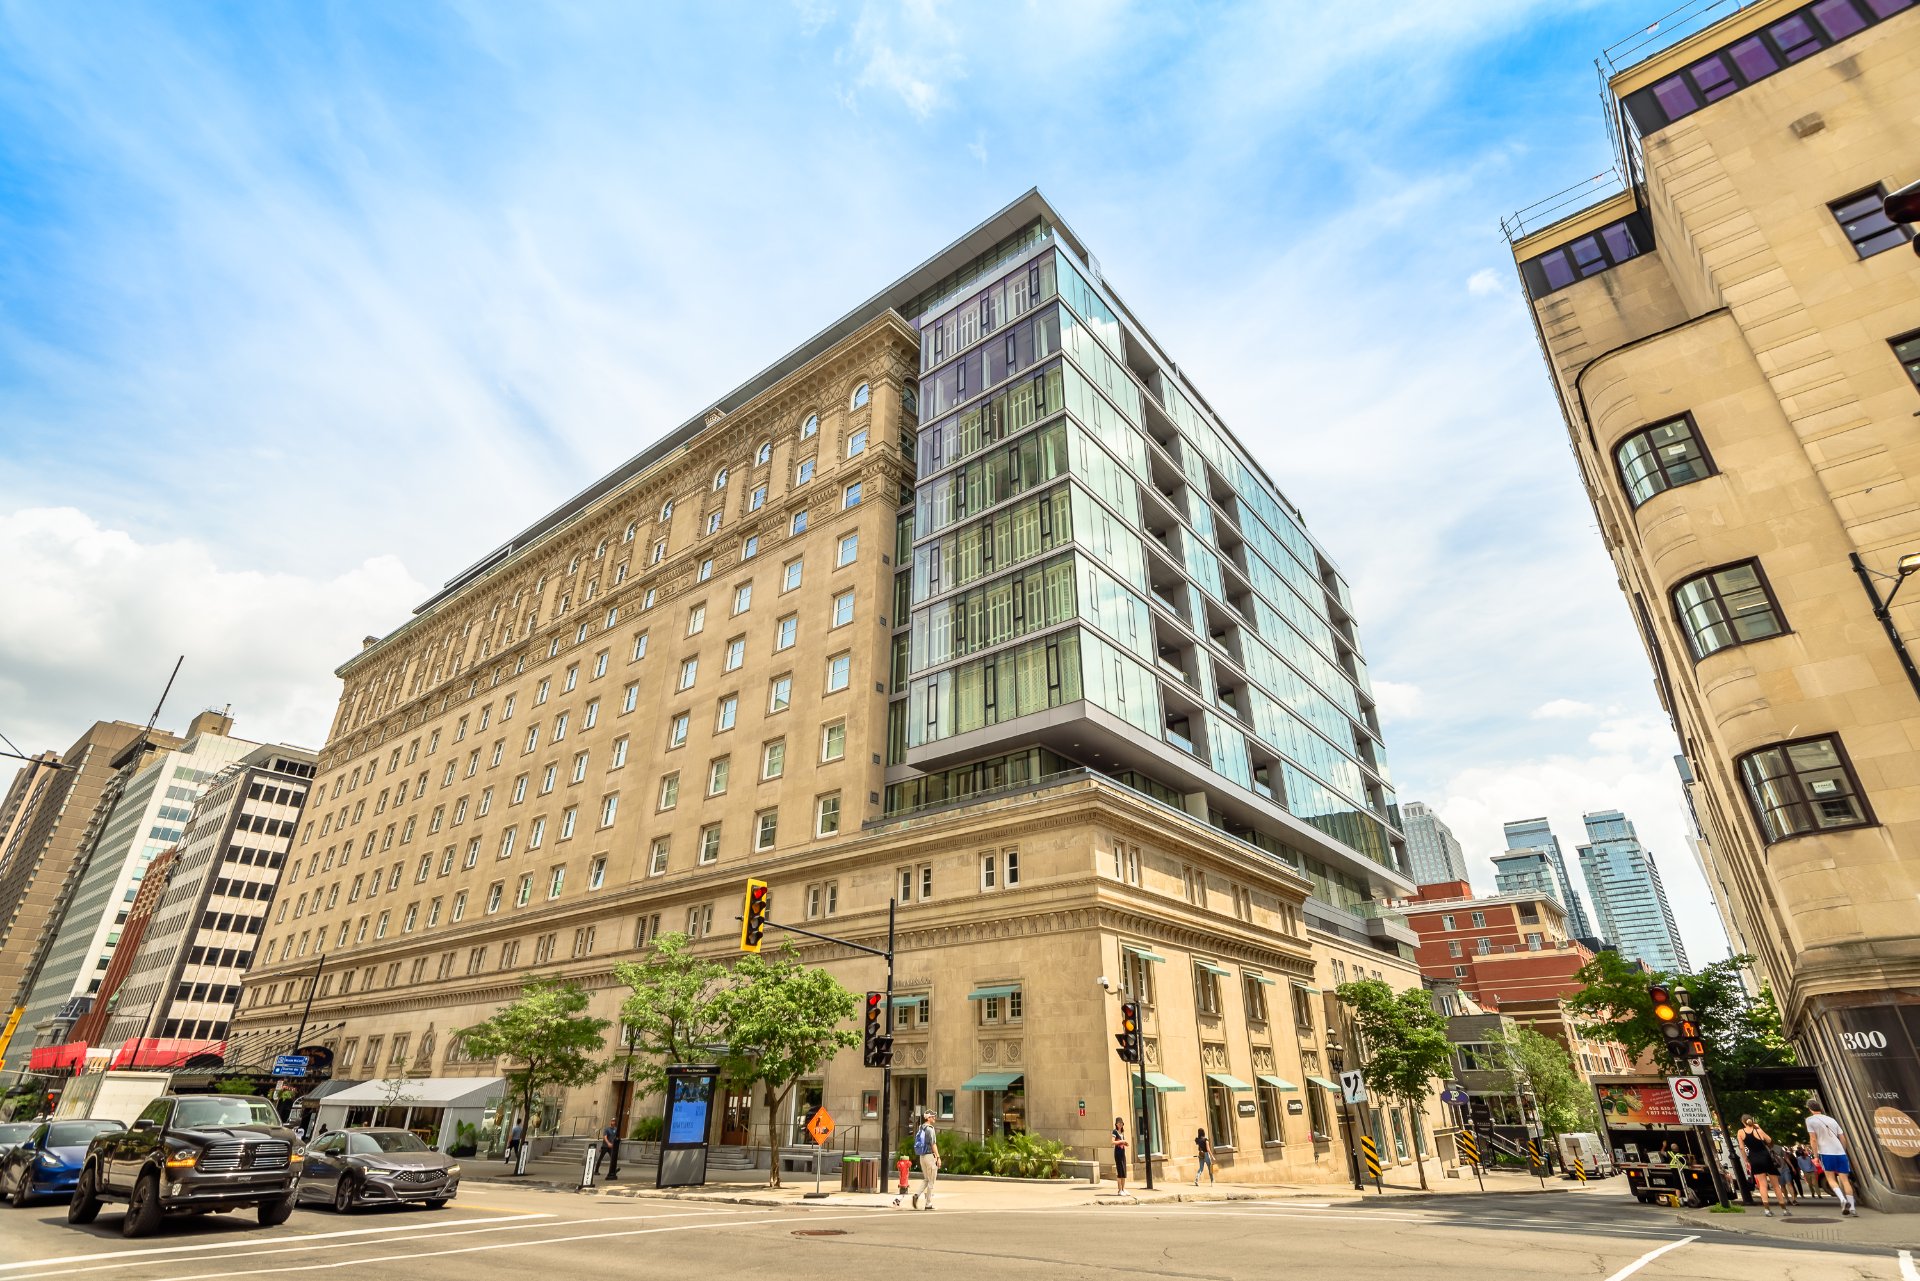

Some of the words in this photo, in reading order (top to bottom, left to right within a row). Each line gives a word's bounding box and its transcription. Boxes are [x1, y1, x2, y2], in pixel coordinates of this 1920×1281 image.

[1838, 1031, 1887, 1050] 1300
[1450, 1090, 1460, 1101] P
[1872, 1092, 1899, 1100] LOUER
[1874, 1116, 1911, 1125] ESPACES
